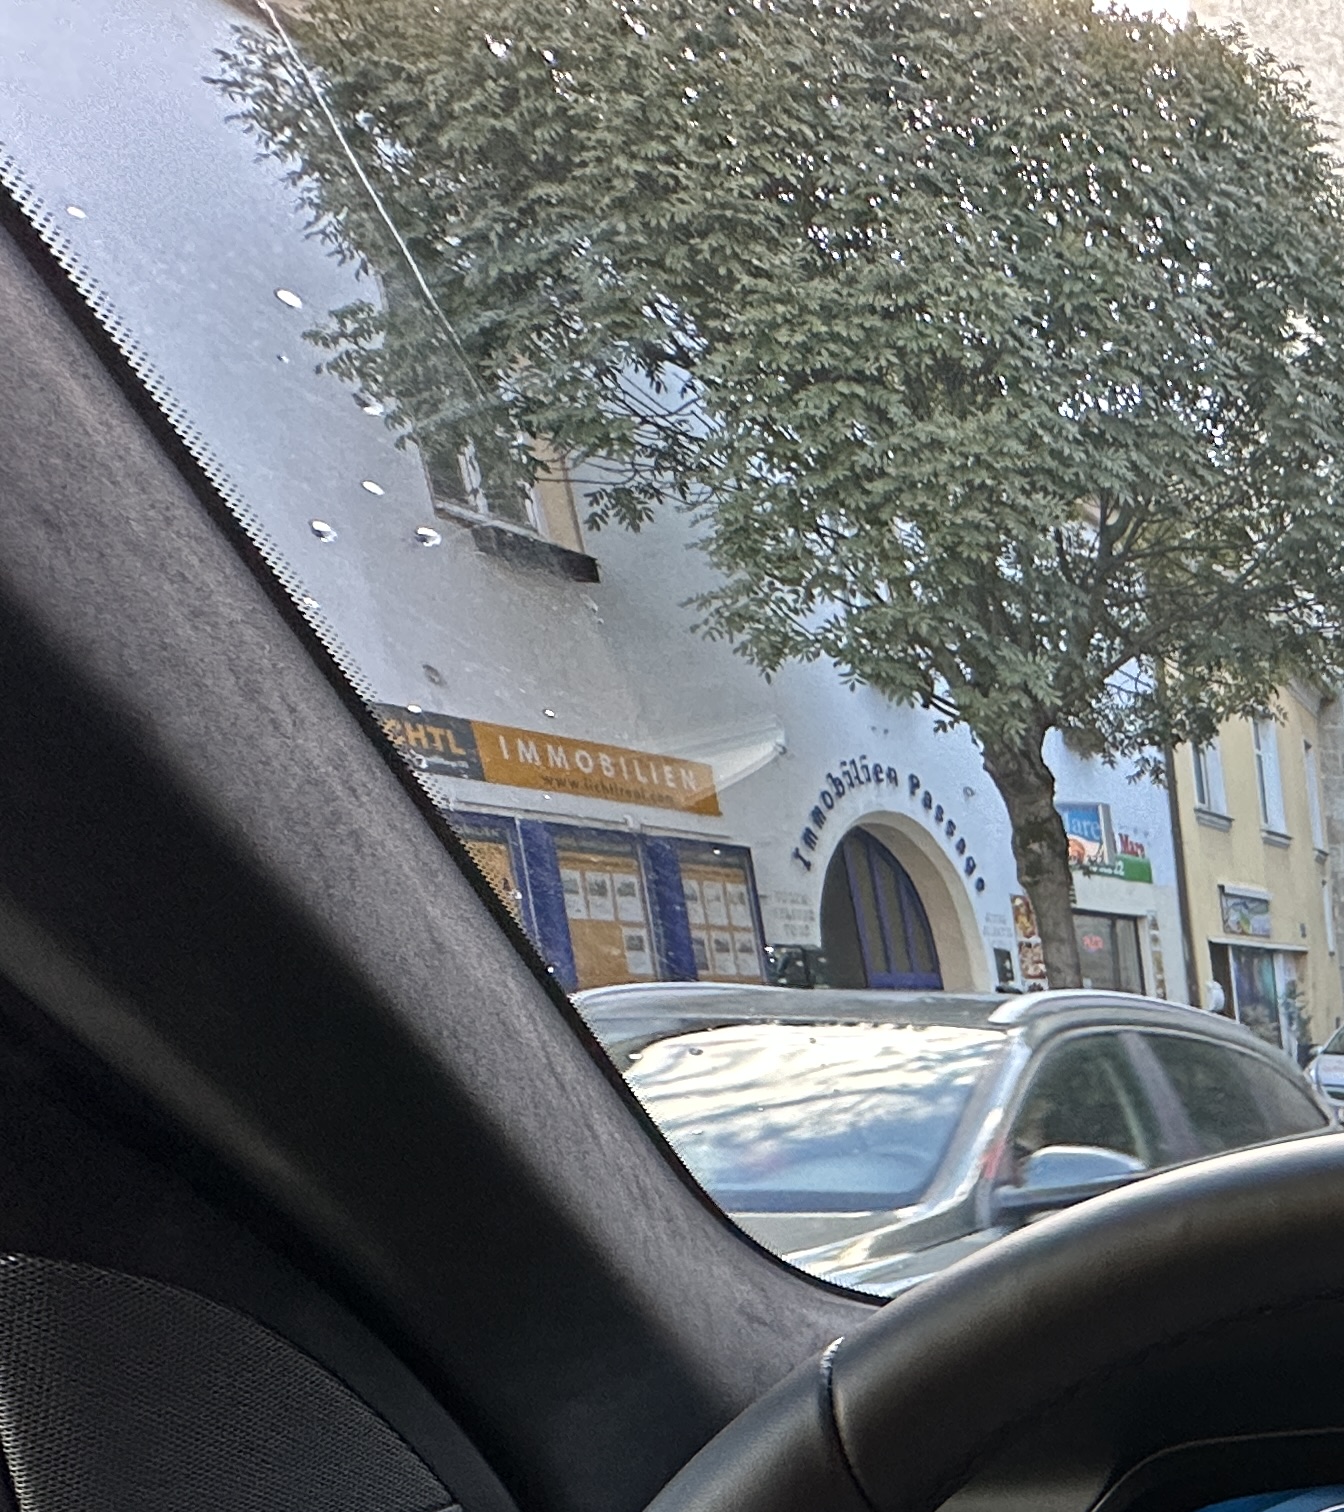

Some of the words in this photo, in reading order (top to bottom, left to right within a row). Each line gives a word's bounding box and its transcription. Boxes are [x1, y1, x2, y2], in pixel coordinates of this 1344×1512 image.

[499, 735, 698, 791] IMMOBILIEN
[792, 754, 899, 872] Immobilien
[908, 773, 986, 893] Passage
